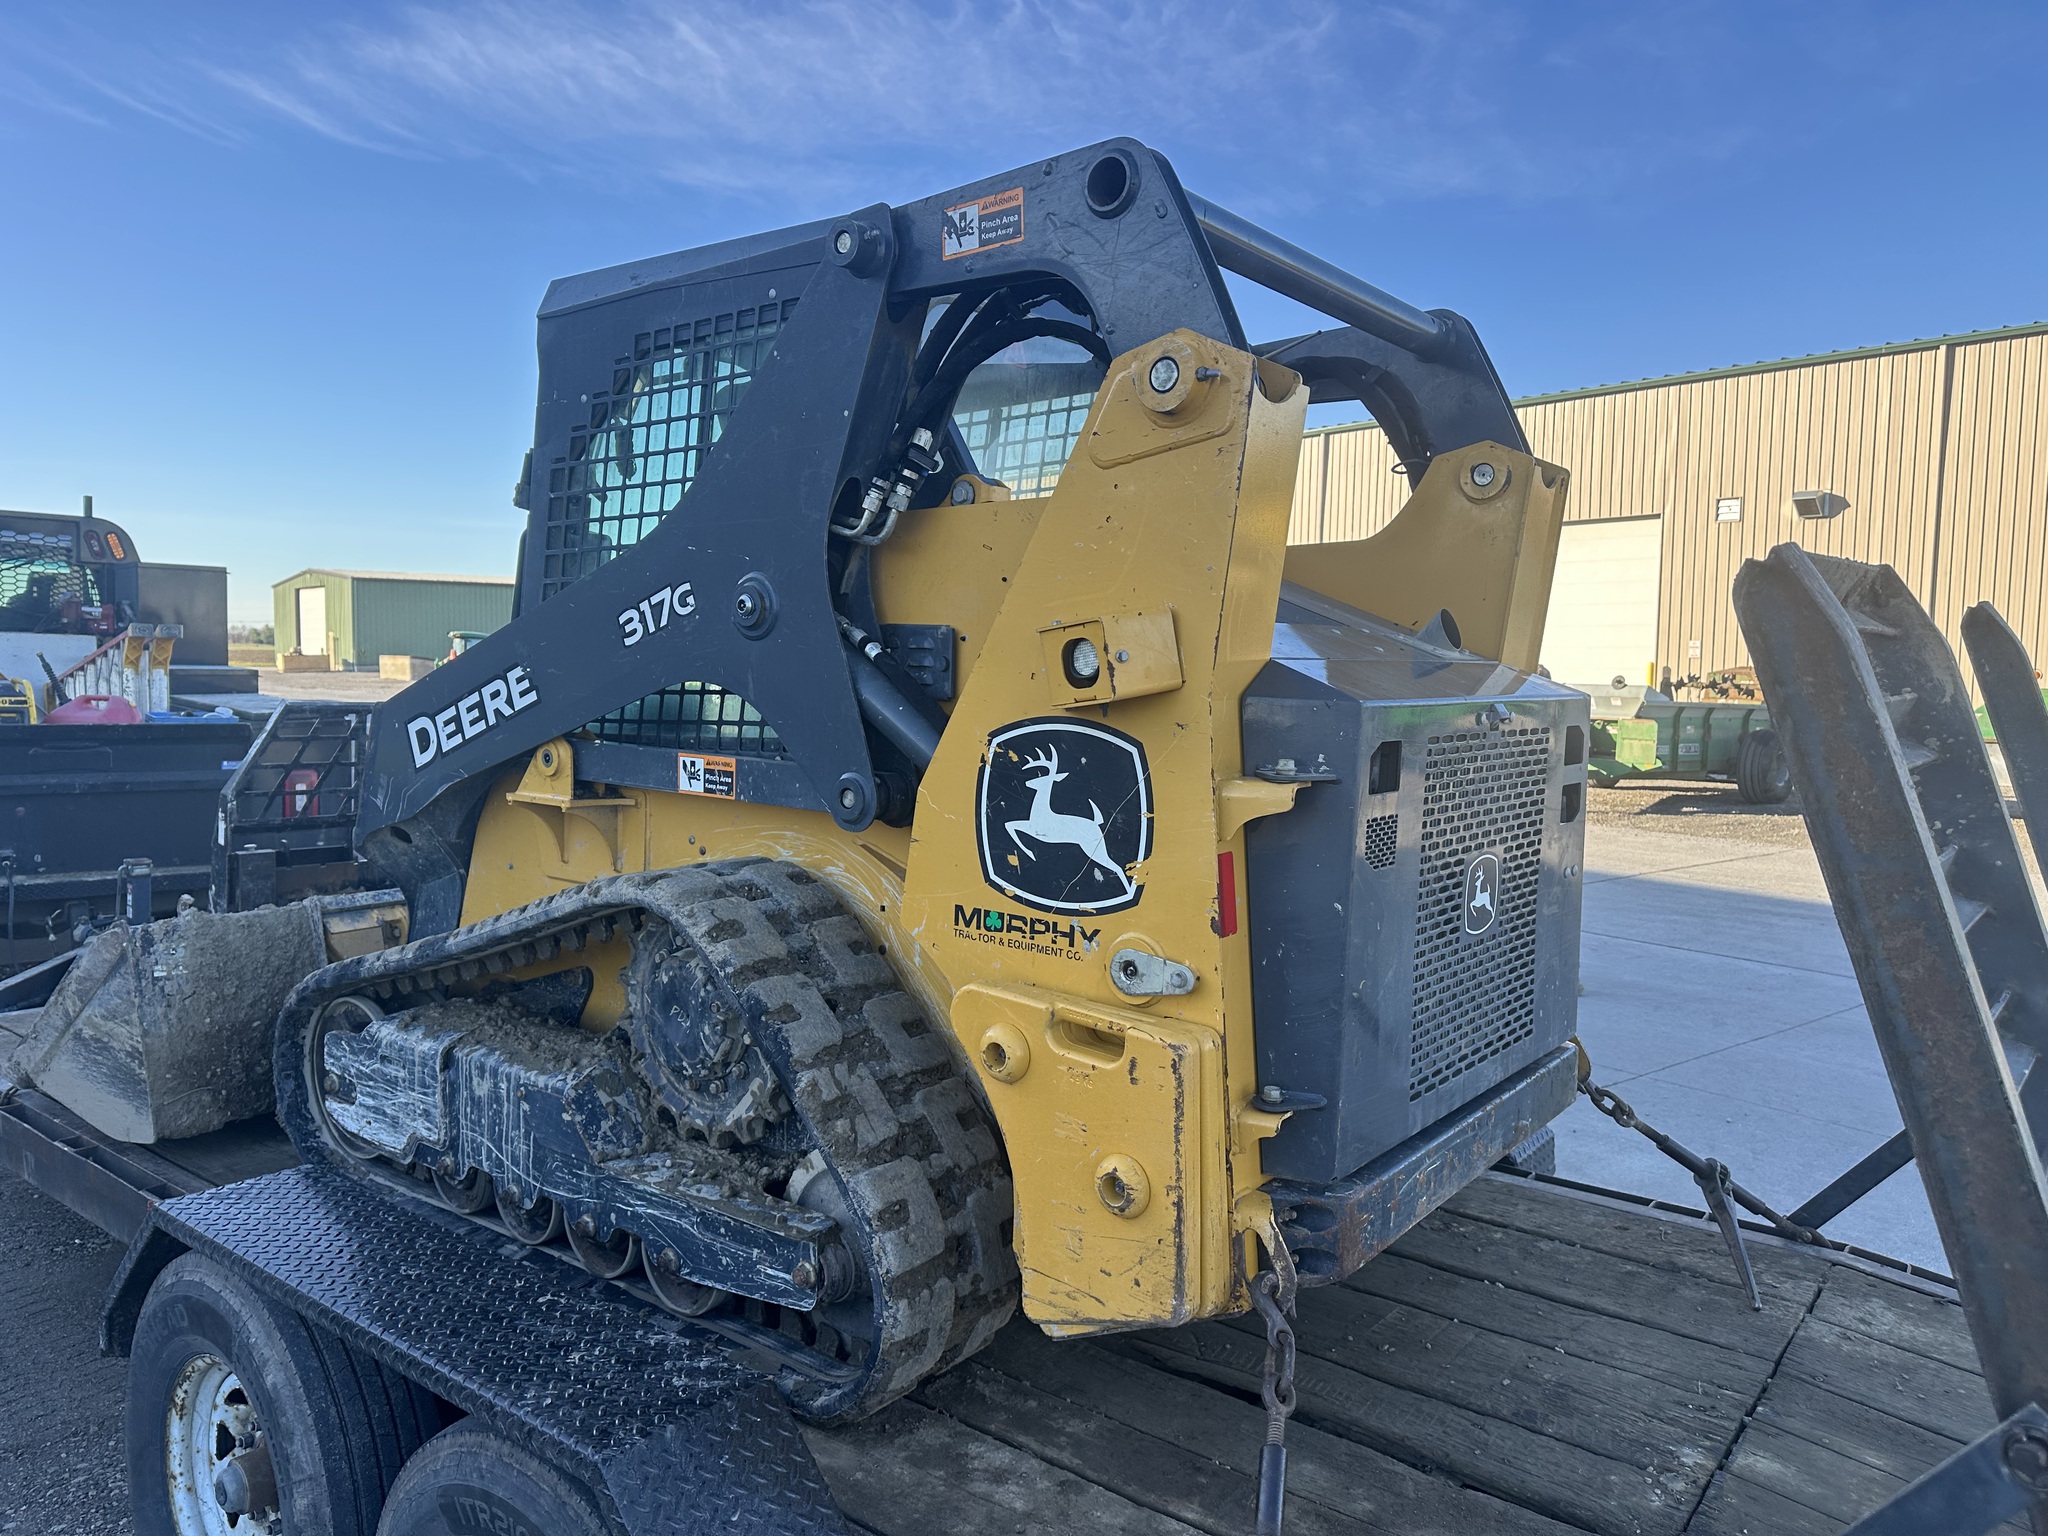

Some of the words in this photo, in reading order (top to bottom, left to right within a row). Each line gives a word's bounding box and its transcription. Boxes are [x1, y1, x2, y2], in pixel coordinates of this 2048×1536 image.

[987, 193, 1020, 208] WARNING
[981, 217, 1001, 230] Pinch
[1001, 213, 1019, 224] Area
[981, 231, 997, 241] Keep
[996, 226, 1014, 236] Away
[617, 581, 696, 646] 317G
[406, 665, 538, 769] DEERE
[709, 760, 733, 768] WARNING
[705, 773, 719, 782] Pinch
[719, 775, 732, 783] Area
[705, 782, 716, 790] Keep
[716, 784, 729, 792] Away
[953, 903, 1102, 949] MURPHY
[998, 937, 1005, 947] &
[1007, 938, 1064, 958] EQUIPMENT
[1066, 949, 1084, 962] CO.
